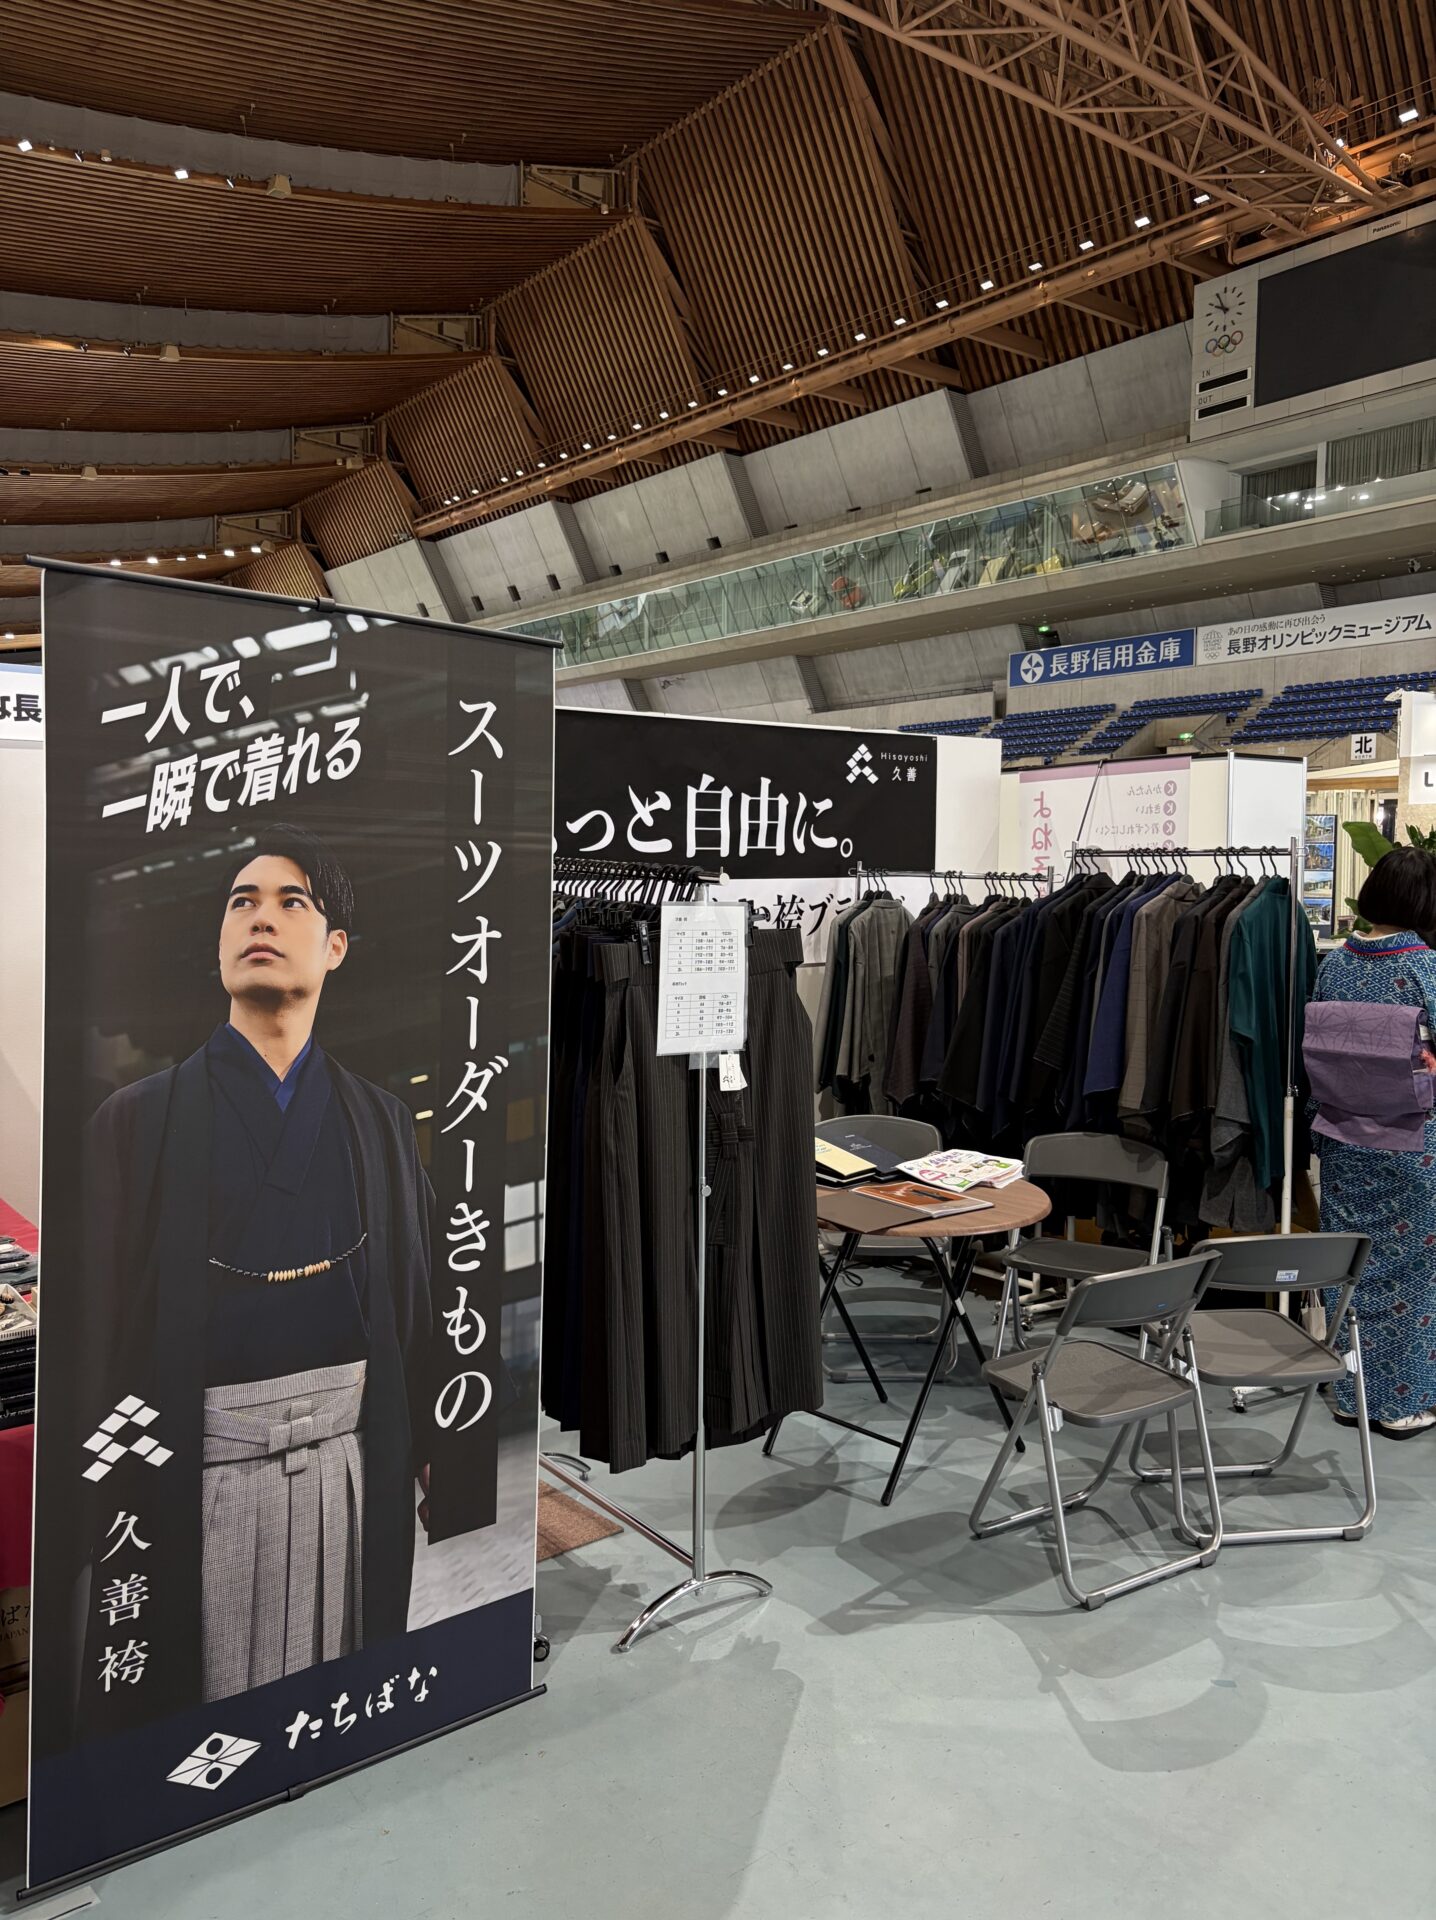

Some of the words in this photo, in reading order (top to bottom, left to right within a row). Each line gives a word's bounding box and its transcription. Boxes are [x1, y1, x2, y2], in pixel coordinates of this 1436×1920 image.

[1373, 220, 1402, 233] Panasonic
[1202, 369, 1211, 378] IN
[1199, 395, 1213, 405] OUT
[1227, 613, 1326, 636] あの日の感動に再び出会う
[1227, 613, 1432, 656] 長野オリンピックミュージアム
[1049, 636, 1182, 678] 長野信用金庫
[101, 660, 255, 744] 一人で、
[880, 752, 928, 763] Hisayoshi
[1355, 736, 1373, 754] 北
[101, 715, 364, 833] 一瞬で着れる
[892, 766, 917, 782] 久善
[552, 773, 854, 858] っと自由に。
[435, 698, 509, 1432] スーツオーダーきもの
[97, 1511, 153, 1693] 久善袴
[284, 1666, 439, 1752] たちばな
